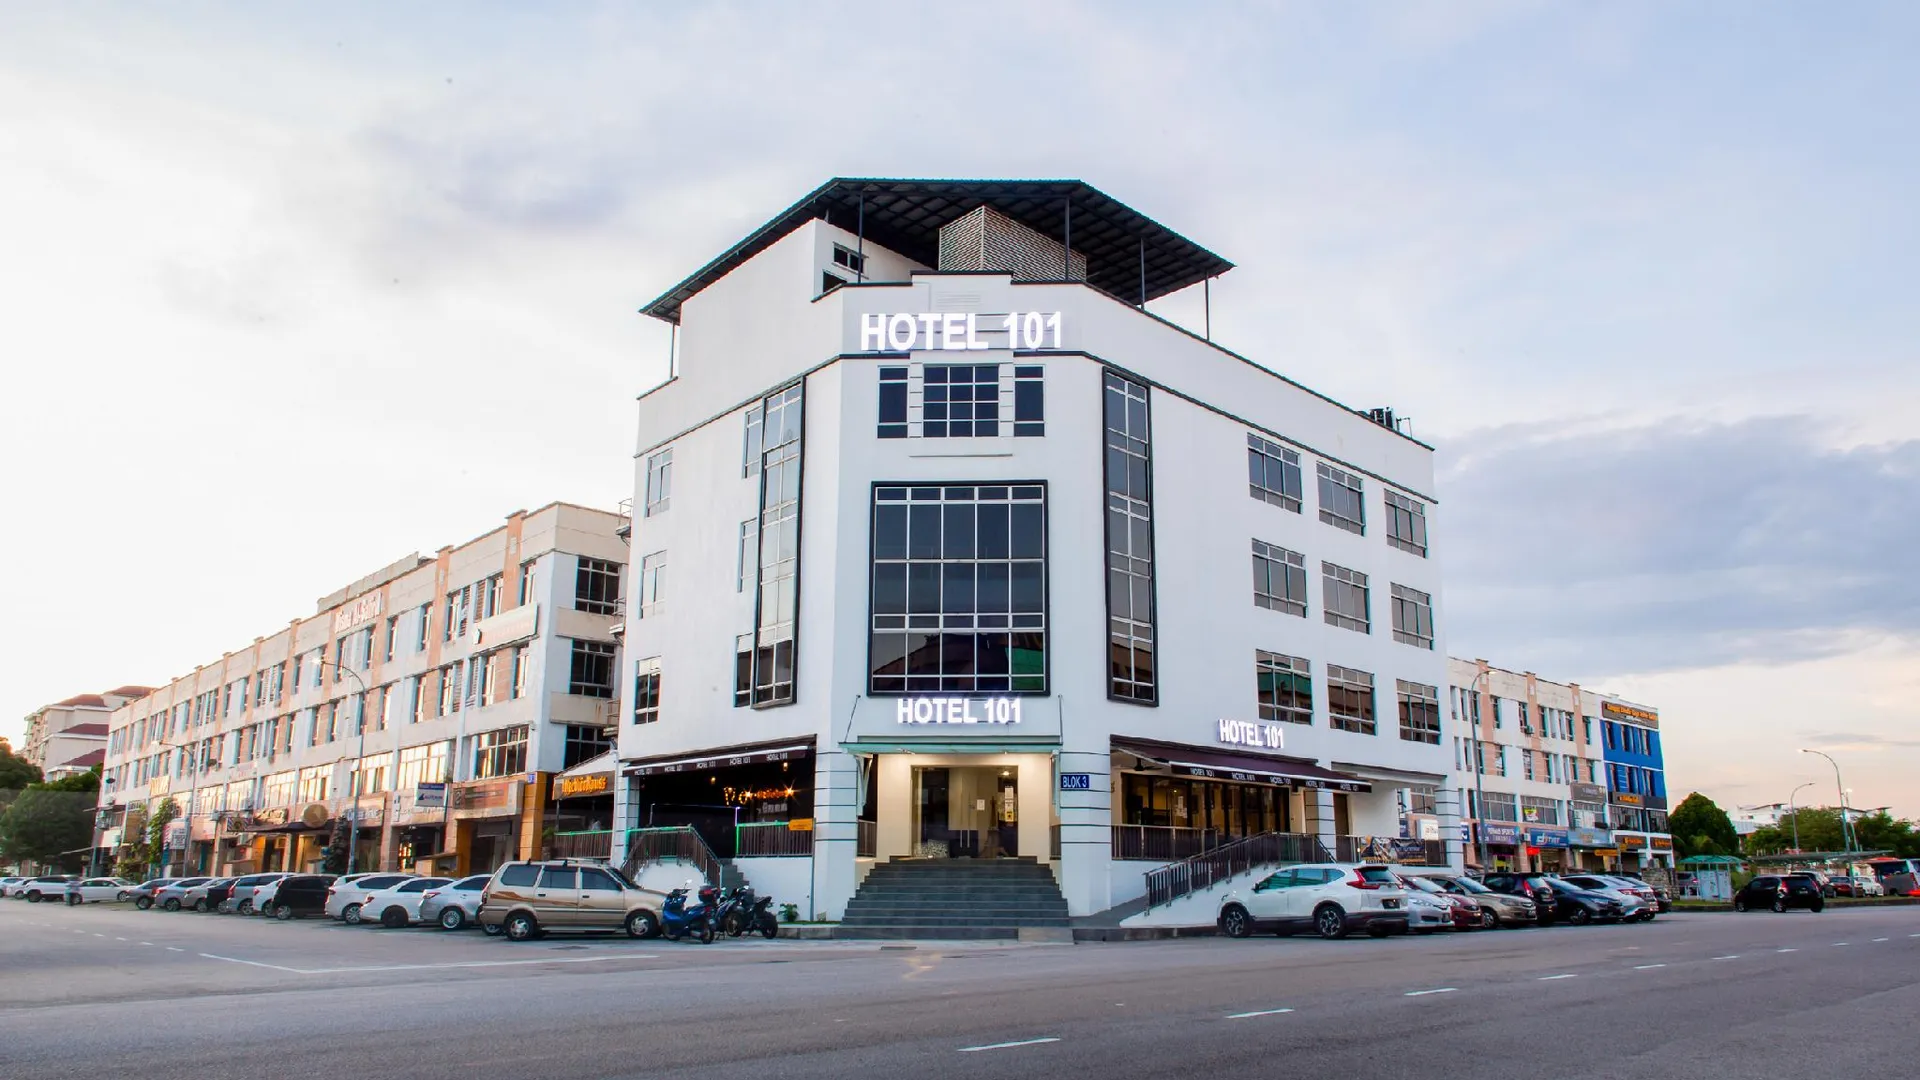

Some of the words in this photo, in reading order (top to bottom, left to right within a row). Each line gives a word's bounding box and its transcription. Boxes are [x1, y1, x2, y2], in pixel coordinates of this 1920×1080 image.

[861, 313, 989, 351] HOTEL
[1003, 311, 1062, 350] 101
[897, 697, 978, 724] HOTEL
[984, 697, 1021, 724] 101
[1219, 718, 1263, 746] HOTEL
[1264, 724, 1285, 749] 101
[1062, 775, 1082, 788] BLOK
[1082, 775, 1088, 788] 3
[1190, 768, 1205, 776] HOTEL
